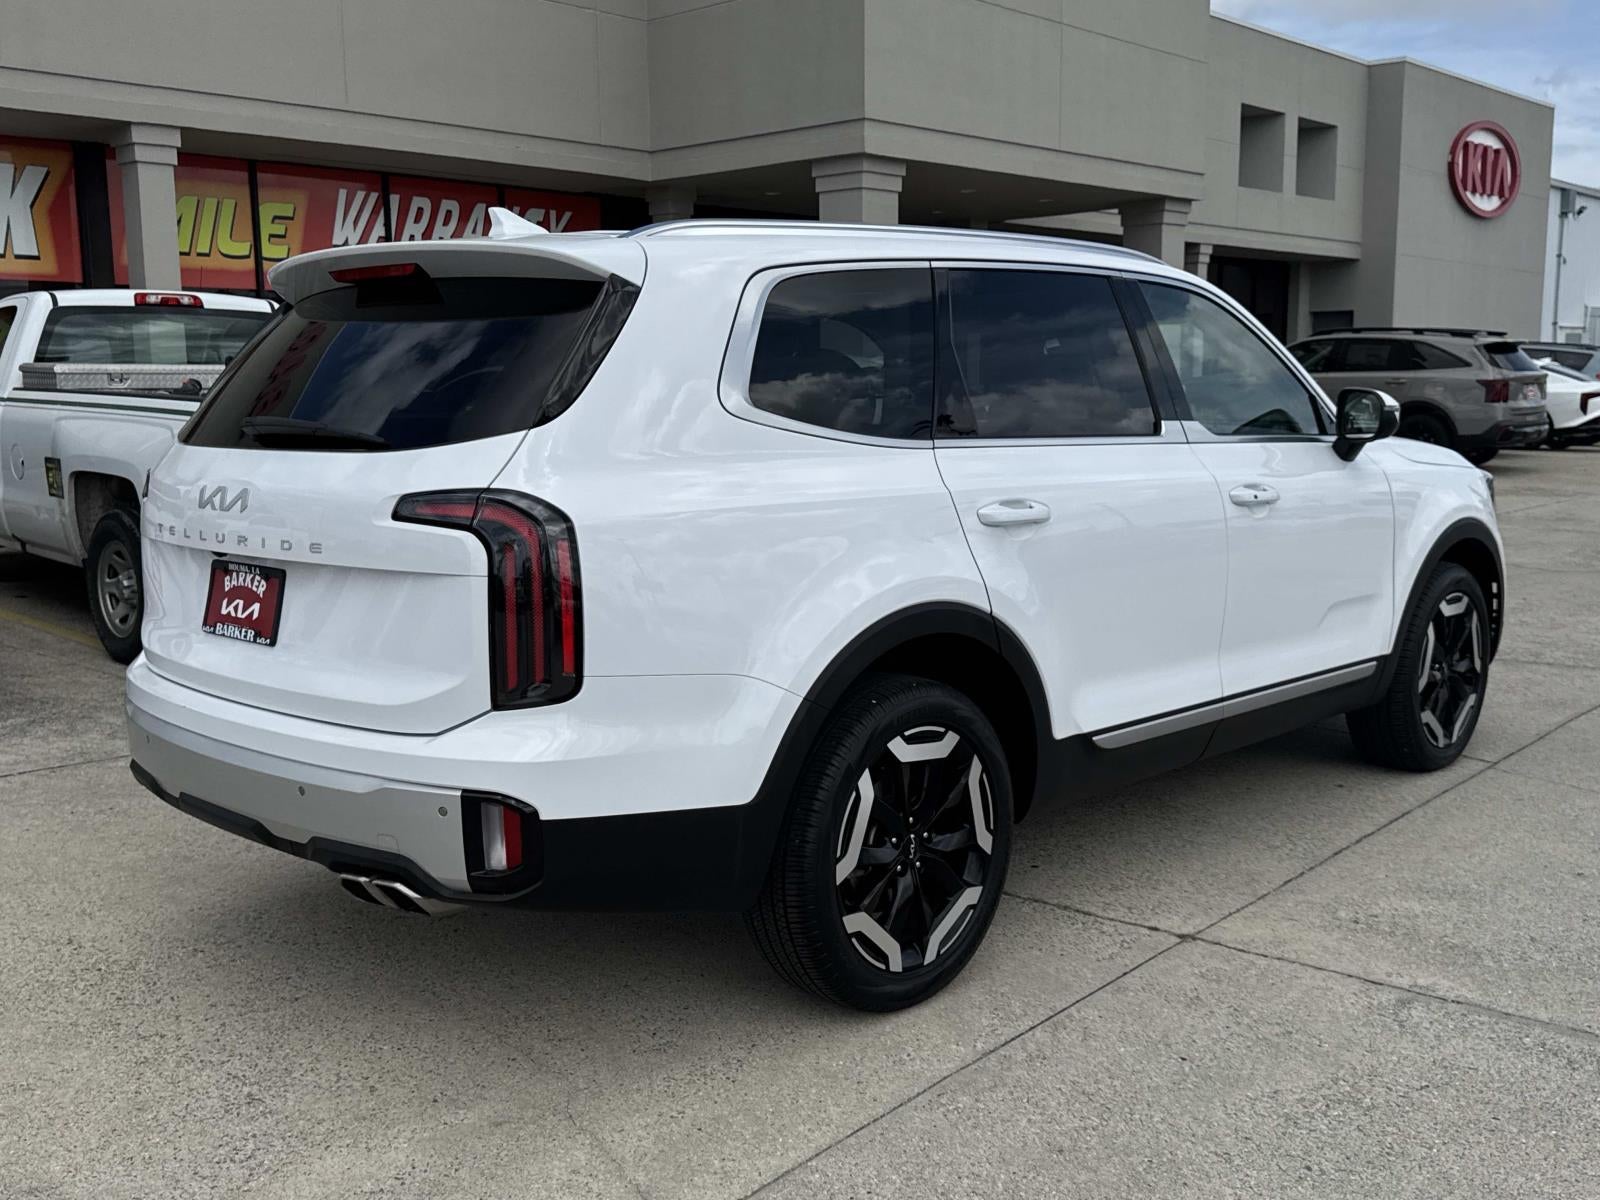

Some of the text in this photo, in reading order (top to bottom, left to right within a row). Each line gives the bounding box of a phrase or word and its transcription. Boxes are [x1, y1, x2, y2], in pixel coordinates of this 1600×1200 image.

[1462, 140, 1509, 200] KIA
[332, 188, 573, 247] WARRAY
[198, 485, 249, 514] KIA
[157, 523, 323, 555] TELLURIDE
[224, 571, 267, 598] BARKER
[220, 597, 261, 621] KIA
[215, 622, 255, 642] BARKER
